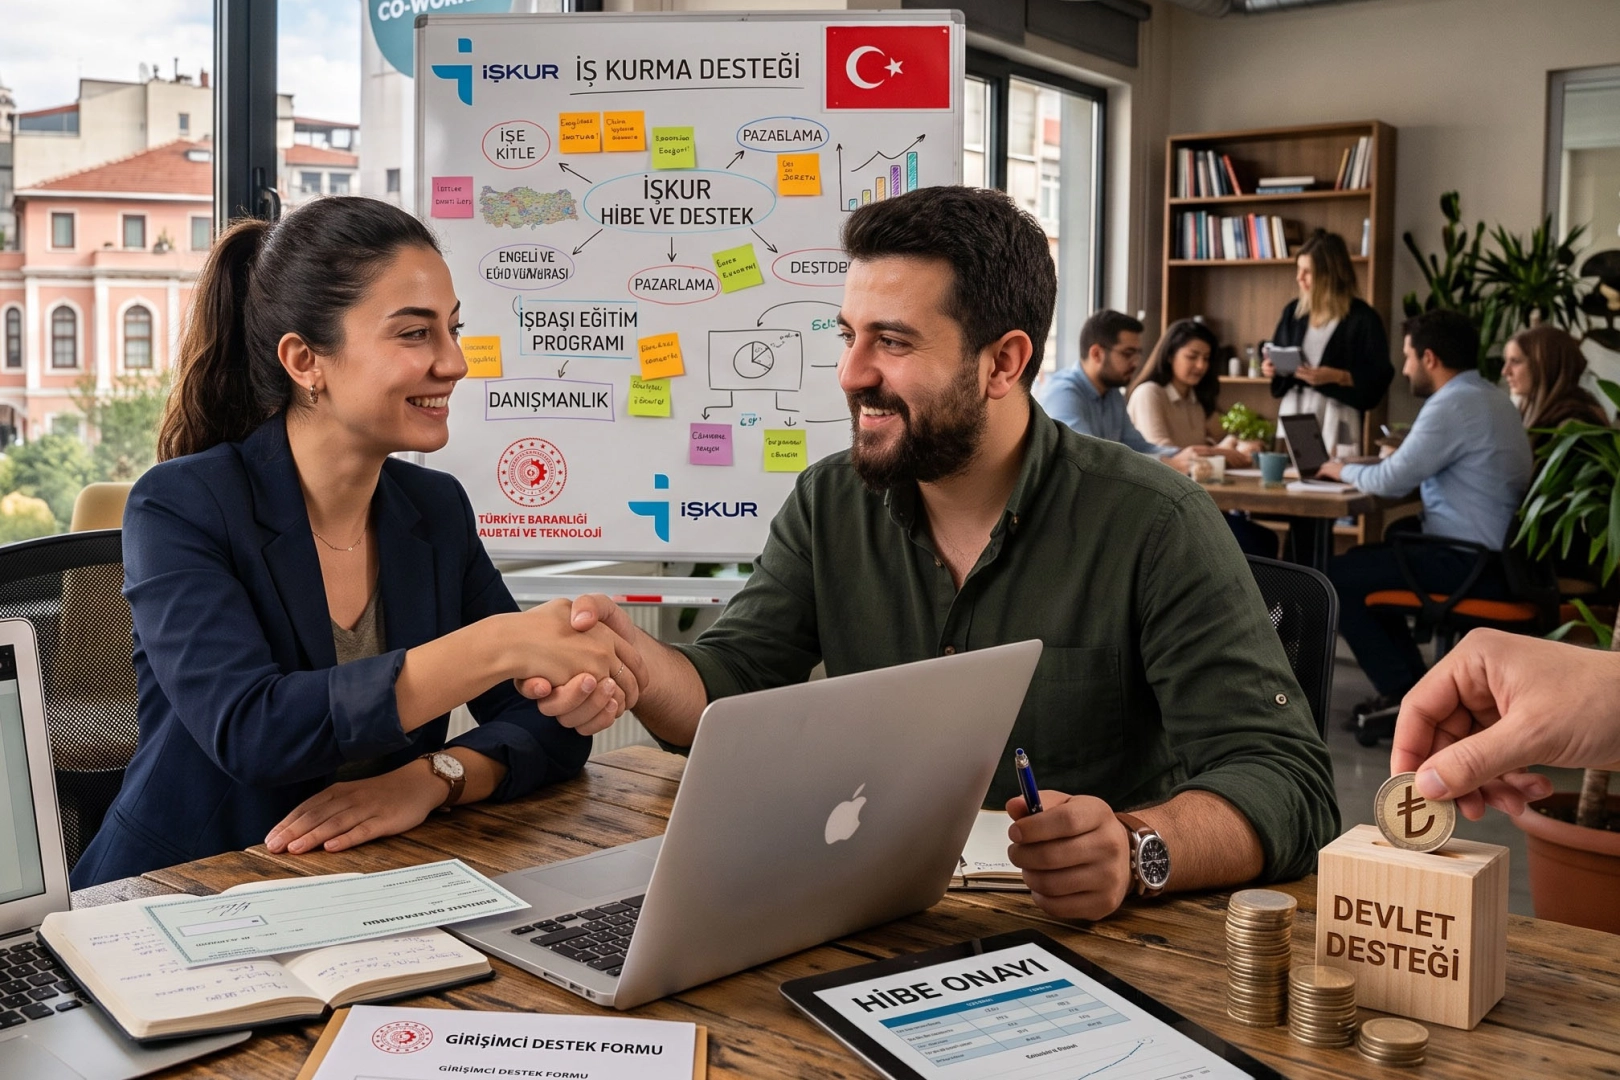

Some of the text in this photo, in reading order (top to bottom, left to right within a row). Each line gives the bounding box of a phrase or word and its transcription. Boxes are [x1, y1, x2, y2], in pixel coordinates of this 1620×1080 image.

[576, 52, 800, 88] İŞ KURMA DESTEĞİ
[500, 128, 526, 145] İŞE
[496, 145, 535, 160] KİTLE
[644, 175, 711, 205] İŞKUR
[601, 204, 754, 225] HİBE VE DESTEK
[540, 251, 555, 263] VE
[634, 278, 715, 291] PAZARLAMA
[520, 307, 638, 332] İŞBAŞI EĞİTİM
[533, 335, 624, 351] PROGRAMI
[489, 392, 608, 412] DANIŞMANLIK
[478, 513, 525, 524] TÜRKİYE
[523, 528, 537, 537] VE
[539, 527, 602, 538] TEKNOLOJİ
[1333, 894, 1455, 940] DEVLET
[1326, 931, 1459, 981] DESTEĞİ
[852, 957, 1049, 1012] HİBE ONAYI
[446, 1032, 663, 1055] GİRİŞİMCİ DESTEK FORMU
[438, 1065, 589, 1079] GİRİŞİMCİ DESTEK FORMU
